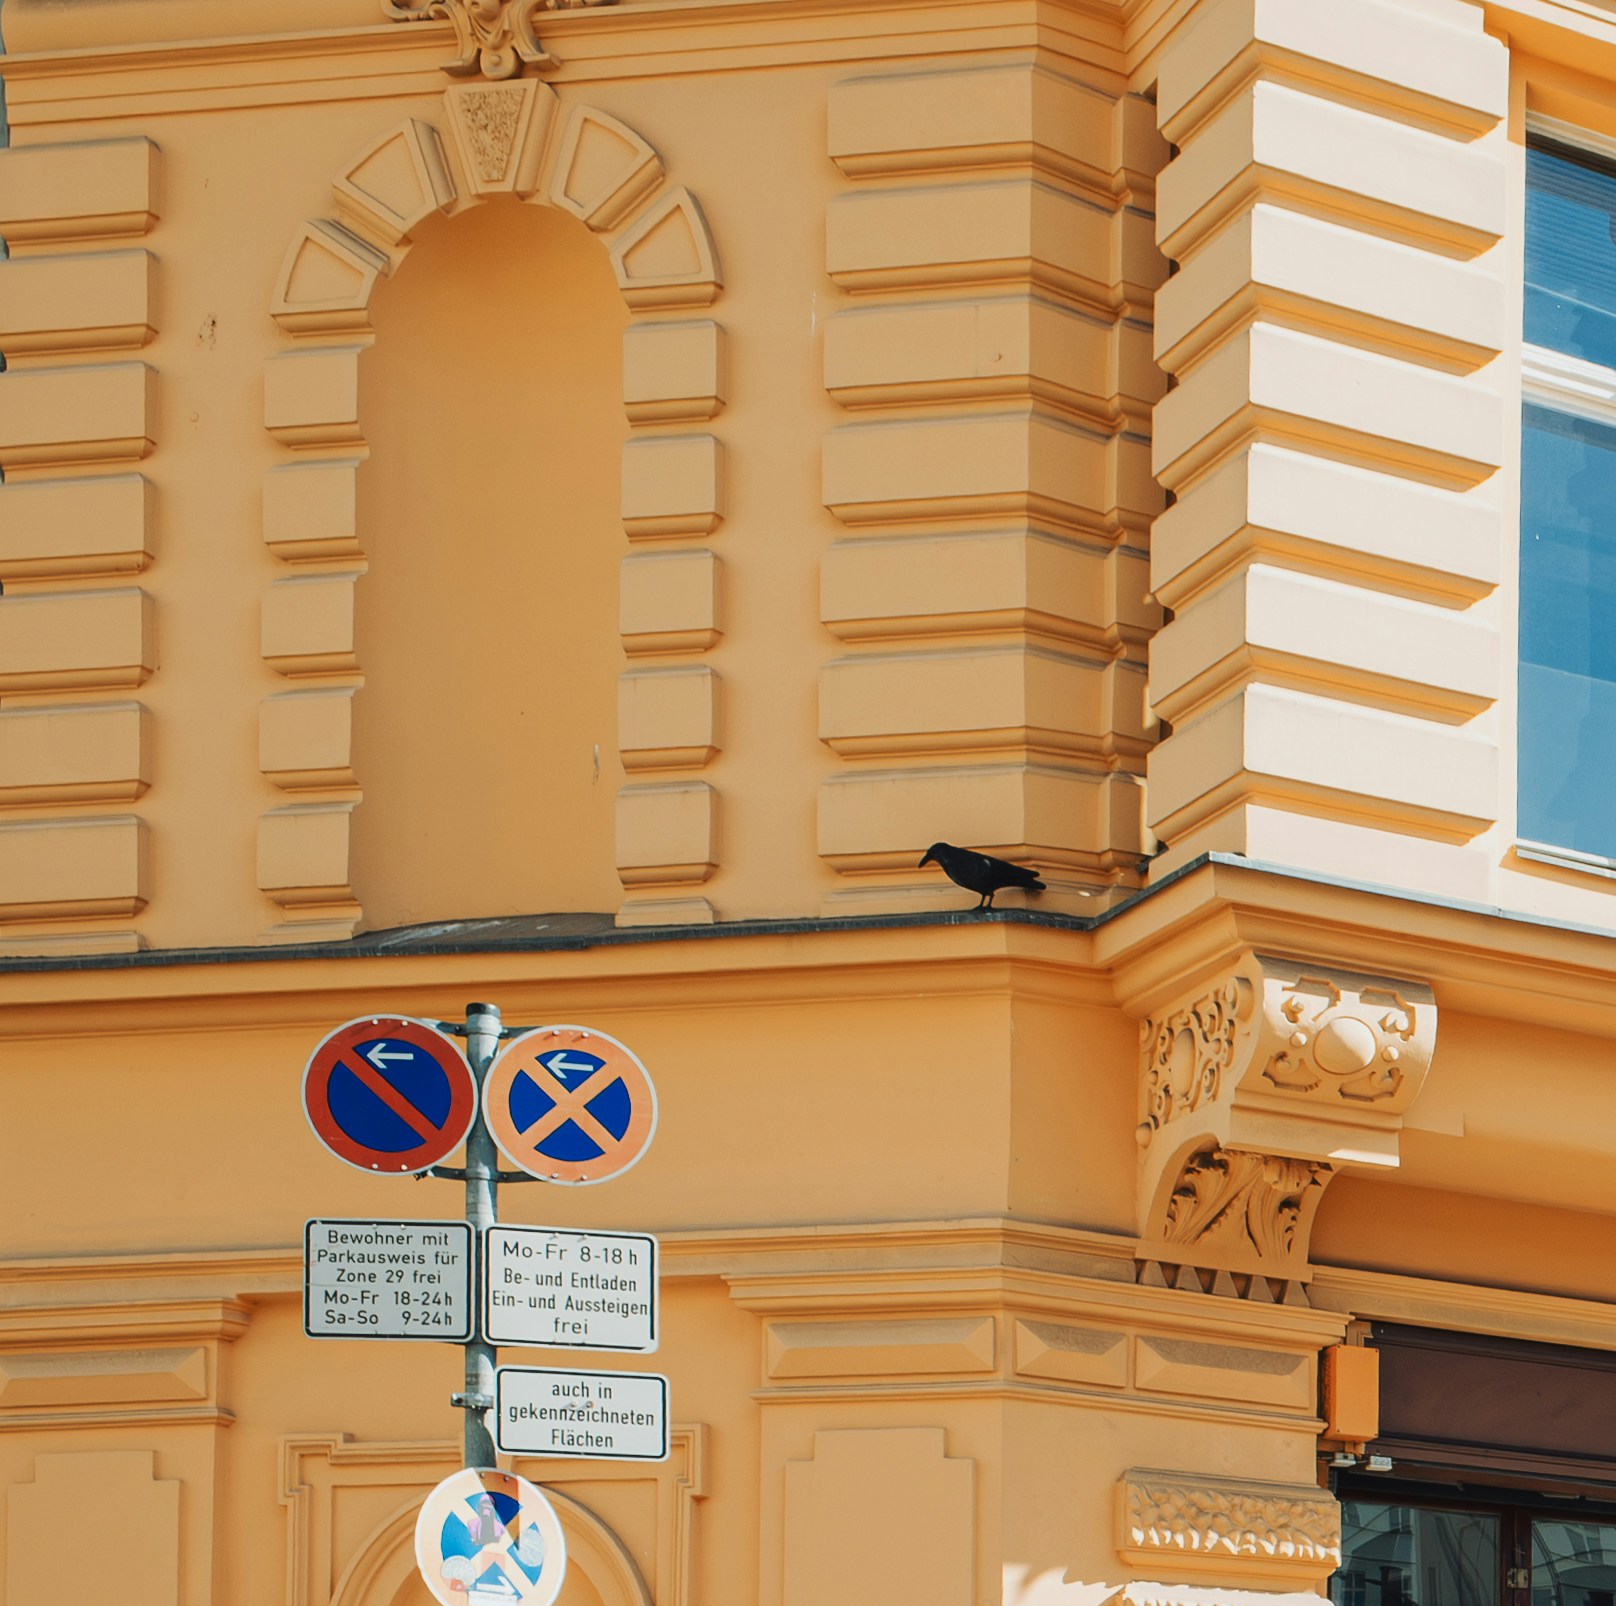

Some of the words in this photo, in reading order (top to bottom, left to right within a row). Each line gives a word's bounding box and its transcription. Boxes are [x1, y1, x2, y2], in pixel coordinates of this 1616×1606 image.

[328, 1230, 413, 1245] Bewohner
[422, 1232, 449, 1246] mit
[317, 1249, 426, 1265] Parkausweis
[435, 1251, 459, 1265] für
[503, 1241, 567, 1260] Mo-Fr
[580, 1246, 623, 1265] 8-18
[336, 1268, 377, 1283] Zone
[385, 1269, 405, 1283] 29
[413, 1270, 442, 1284] frei
[504, 1267, 530, 1284] Be-
[536, 1271, 563, 1287] und
[571, 1272, 637, 1291] Entladen
[324, 1290, 379, 1305] Mo-Fr
[492, 1290, 523, 1306] Ein-
[529, 1294, 556, 1309] und
[565, 1295, 648, 1318] Aussteigen
[325, 1309, 379, 1325] Sa-So
[554, 1317, 588, 1334] frei
[552, 1381, 590, 1398] auch
[598, 1382, 612, 1399] in
[509, 1403, 655, 1426] gekennzeichneten
[551, 1428, 614, 1448] Flächen
